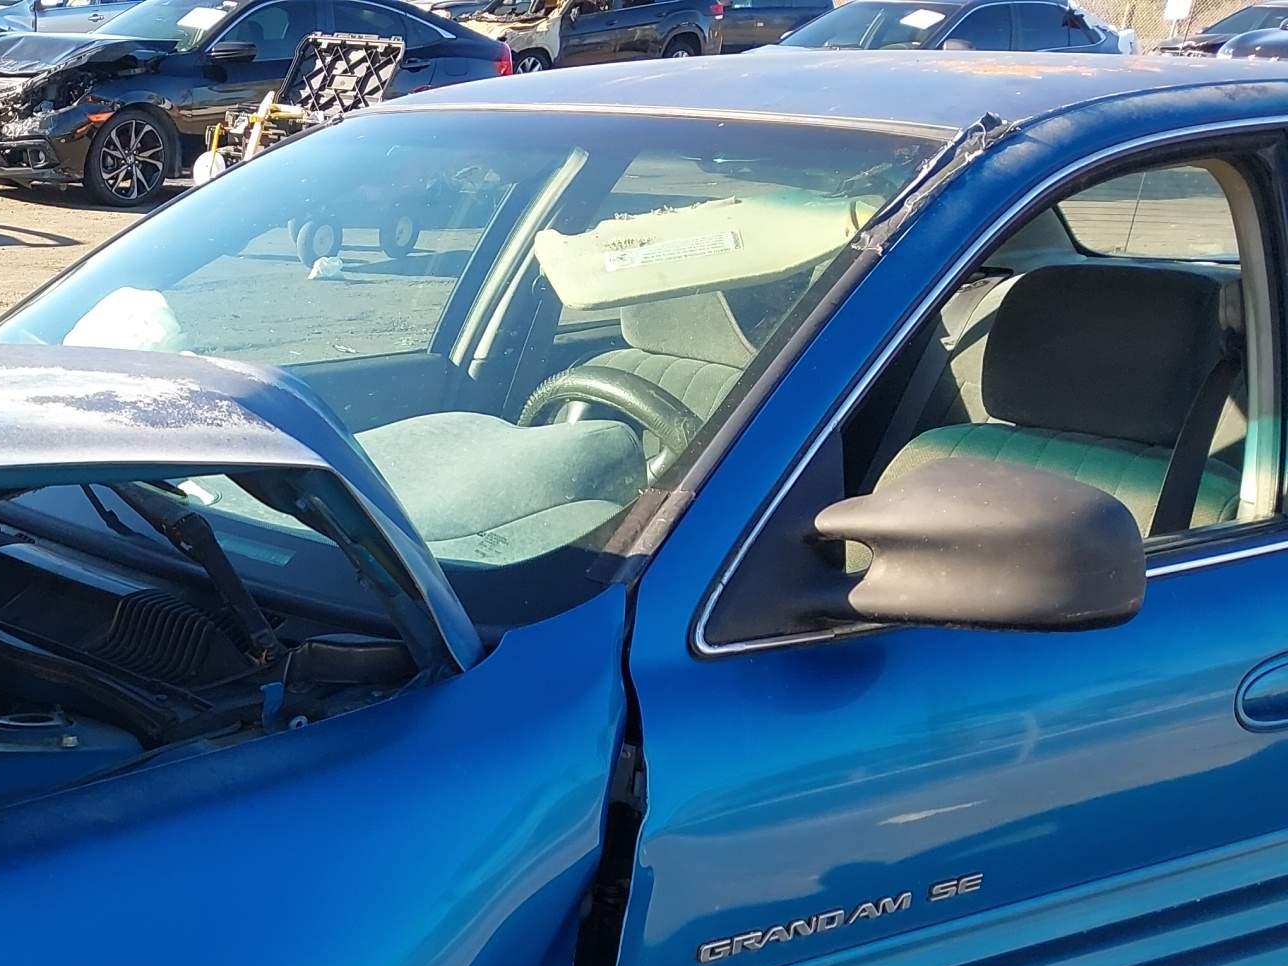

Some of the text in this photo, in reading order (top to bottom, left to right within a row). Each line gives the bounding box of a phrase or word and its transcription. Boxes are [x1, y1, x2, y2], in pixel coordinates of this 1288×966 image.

[696, 872, 984, 965] GRAND AM SE
